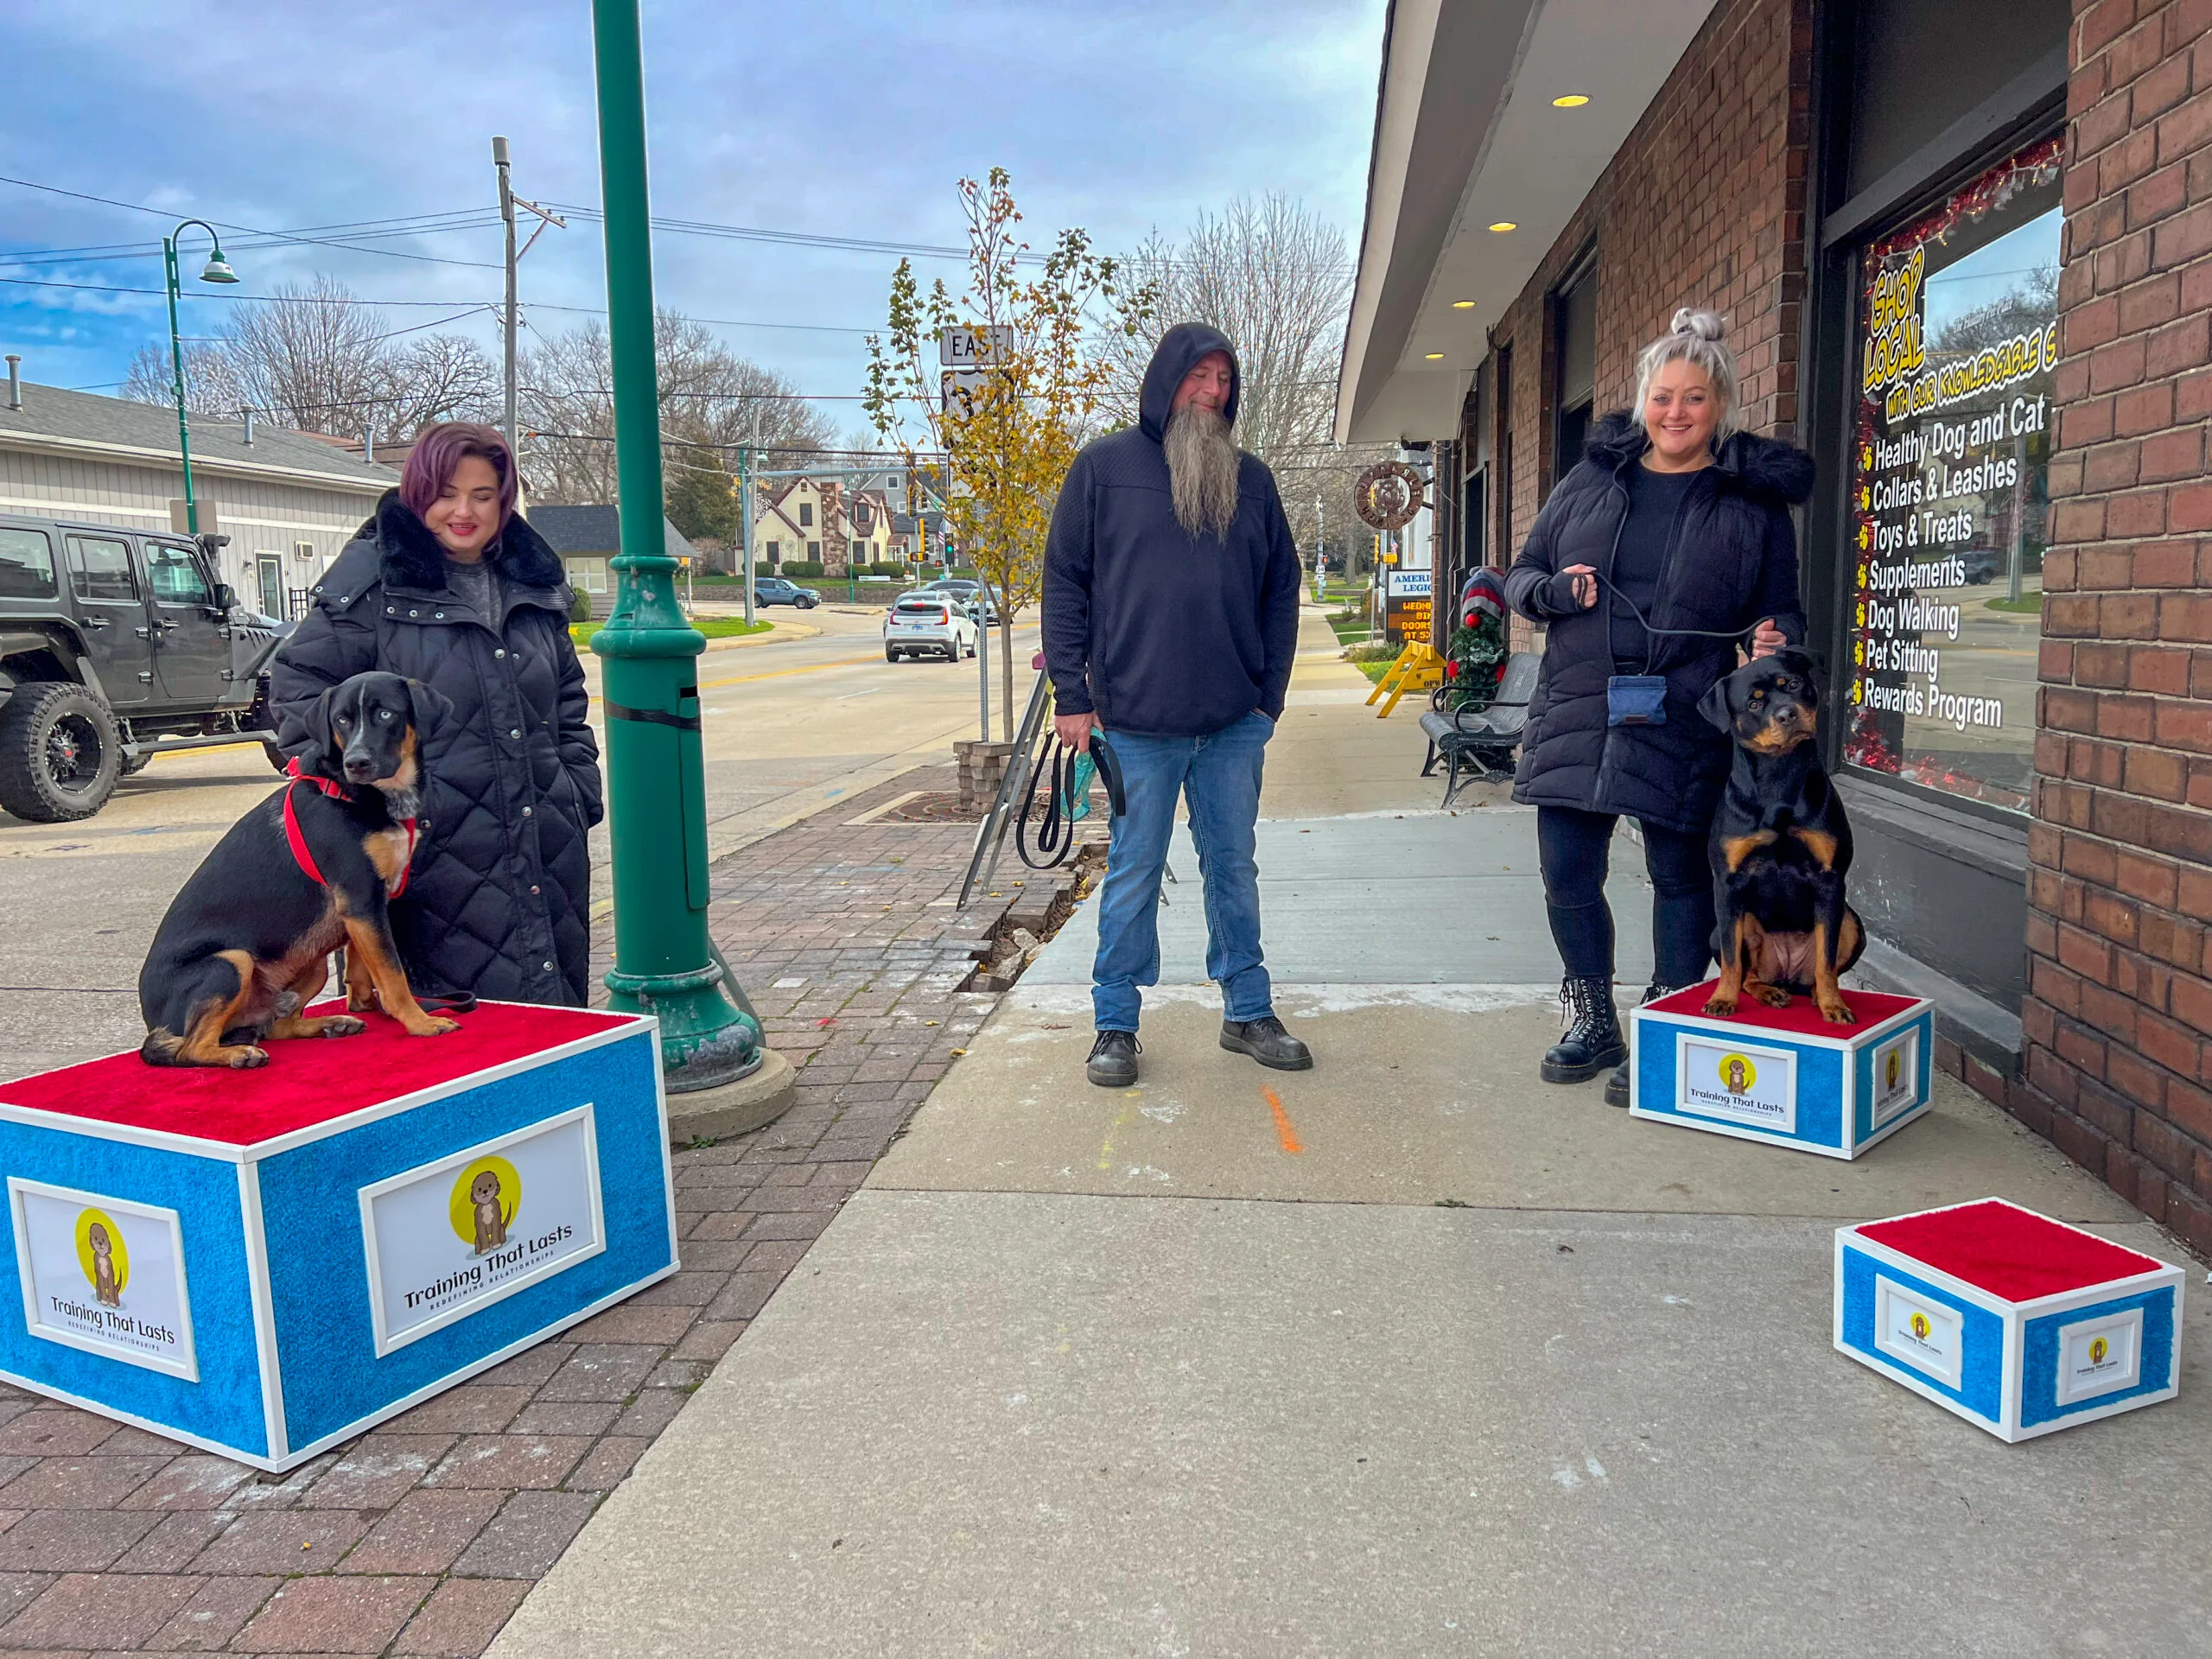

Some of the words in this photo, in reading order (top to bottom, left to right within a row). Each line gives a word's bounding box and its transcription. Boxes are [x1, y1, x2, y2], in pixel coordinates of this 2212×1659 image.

[1872, 247, 1924, 334] SHOP
[1865, 317, 1924, 391] LOCAL
[1887, 385, 1909, 421] WITH
[1912, 376, 1936, 410] OUR
[1940, 335, 2039, 401] KNOWLEDGABLE
[1875, 429, 1928, 471] Healthy
[1933, 422, 1965, 460] Dog
[1971, 403, 2005, 448] and
[2011, 392, 2045, 435] Cat
[1873, 478, 1922, 512] Collars
[1927, 473, 1937, 501] &
[1942, 455, 2018, 497] Leashes
[1872, 519, 1904, 557] Toys
[1907, 516, 1917, 547] &
[1923, 507, 1973, 543] Treats
[1870, 554, 1965, 597] Supplements
[1868, 600, 1895, 638] Dog
[1899, 598, 1960, 640] Walking
[1866, 639, 1888, 670] Pet
[1891, 639, 1939, 682] Sitting
[1865, 677, 1923, 715] Rewards
[1928, 684, 2002, 731] Program
[1690, 1089, 1730, 1104] Training
[1732, 1096, 1755, 1107] That
[1758, 1102, 1784, 1113] Lasts
[404, 1266, 481, 1309] Training
[486, 1243, 524, 1272] That
[529, 1225, 572, 1254] Lasts
[430, 1282, 485, 1310] REDEFINING
[489, 1250, 555, 1283] RELATIONSHIPS
[51, 1296, 102, 1328] Training
[105, 1312, 135, 1332] That
[138, 1320, 175, 1344] Lasts
[68, 1320, 105, 1336] REDEFINING
[108, 1331, 160, 1351] RELATIONSHIPS
